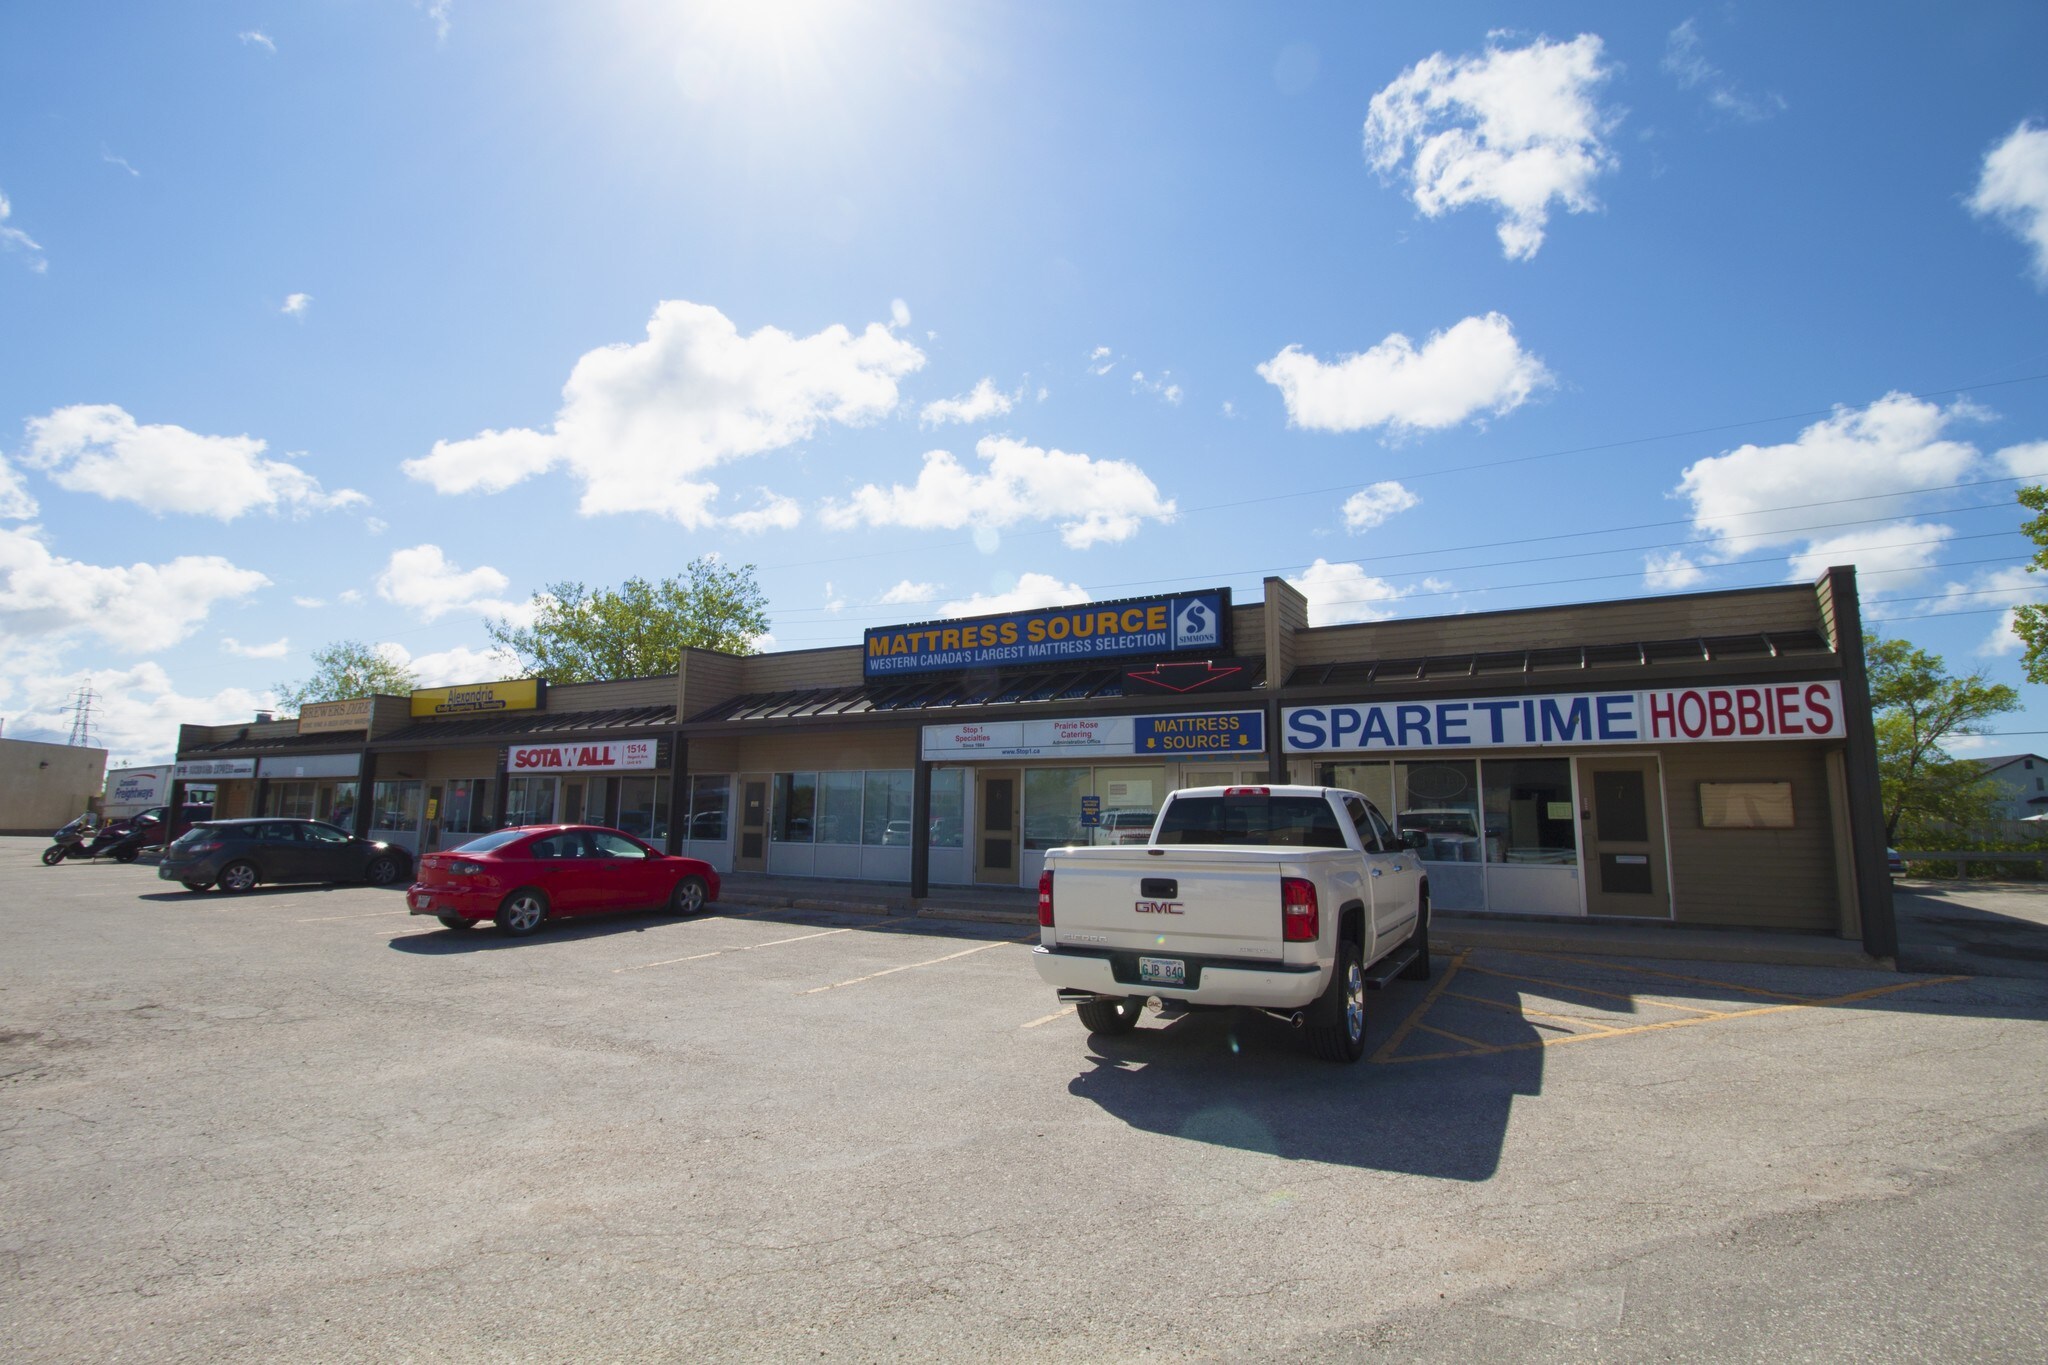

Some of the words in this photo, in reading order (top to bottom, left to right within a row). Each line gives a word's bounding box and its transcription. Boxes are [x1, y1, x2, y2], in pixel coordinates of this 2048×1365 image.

[869, 621, 1018, 657] MATTRESS
[1027, 606, 1167, 642] SOURCE
[1179, 634, 1214, 643] SIMMONS
[870, 656, 917, 670] WESTERN
[920, 651, 972, 666] CANADA'S
[975, 645, 1025, 661] LARGEST
[1028, 639, 1091, 657] MATTRESS
[1096, 632, 1166, 651] SELECTION
[448, 685, 494, 703] Alexandria
[303, 704, 345, 718] BREWERS
[1650, 684, 1834, 738] HOBBIES
[1154, 717, 1240, 732] MATTRESS
[1287, 695, 1637, 750] SPARETIME
[963, 727, 978, 735] Stop
[1061, 731, 1092, 739] Catering
[627, 744, 647, 753] 1514
[1163, 734, 1230, 749] SOURCE
[115, 787, 154, 801] Freightways
[1616, 786, 1623, 799] 7
[1135, 901, 1184, 914] GMC
[1063, 932, 1108, 942] SIERRA
[1142, 963, 1160, 976] GJB
[1165, 966, 1183, 978] 840
